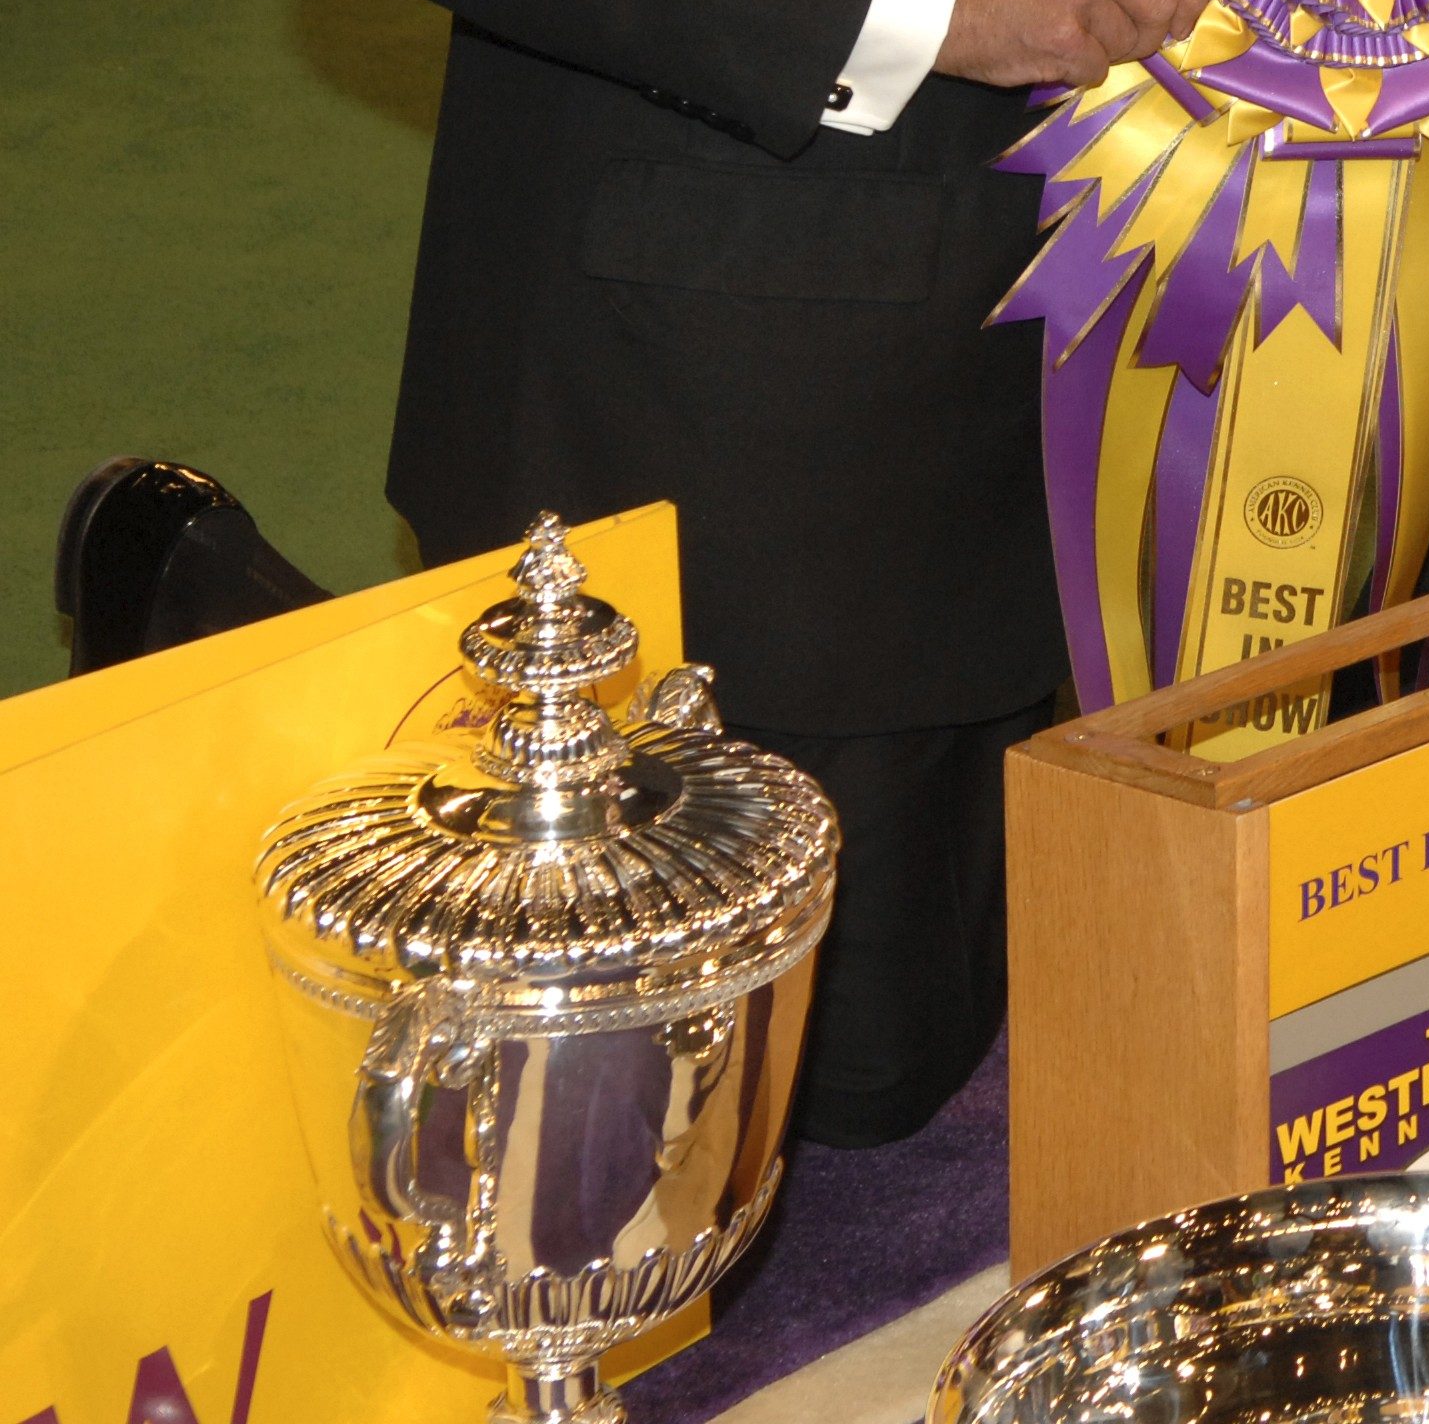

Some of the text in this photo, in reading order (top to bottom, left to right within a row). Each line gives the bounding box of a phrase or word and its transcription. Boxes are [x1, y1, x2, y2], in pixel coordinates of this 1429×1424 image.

[1258, 490, 1306, 535] AKC
[1220, 576, 1325, 627] BEST
[1298, 840, 1410, 923] BEST
